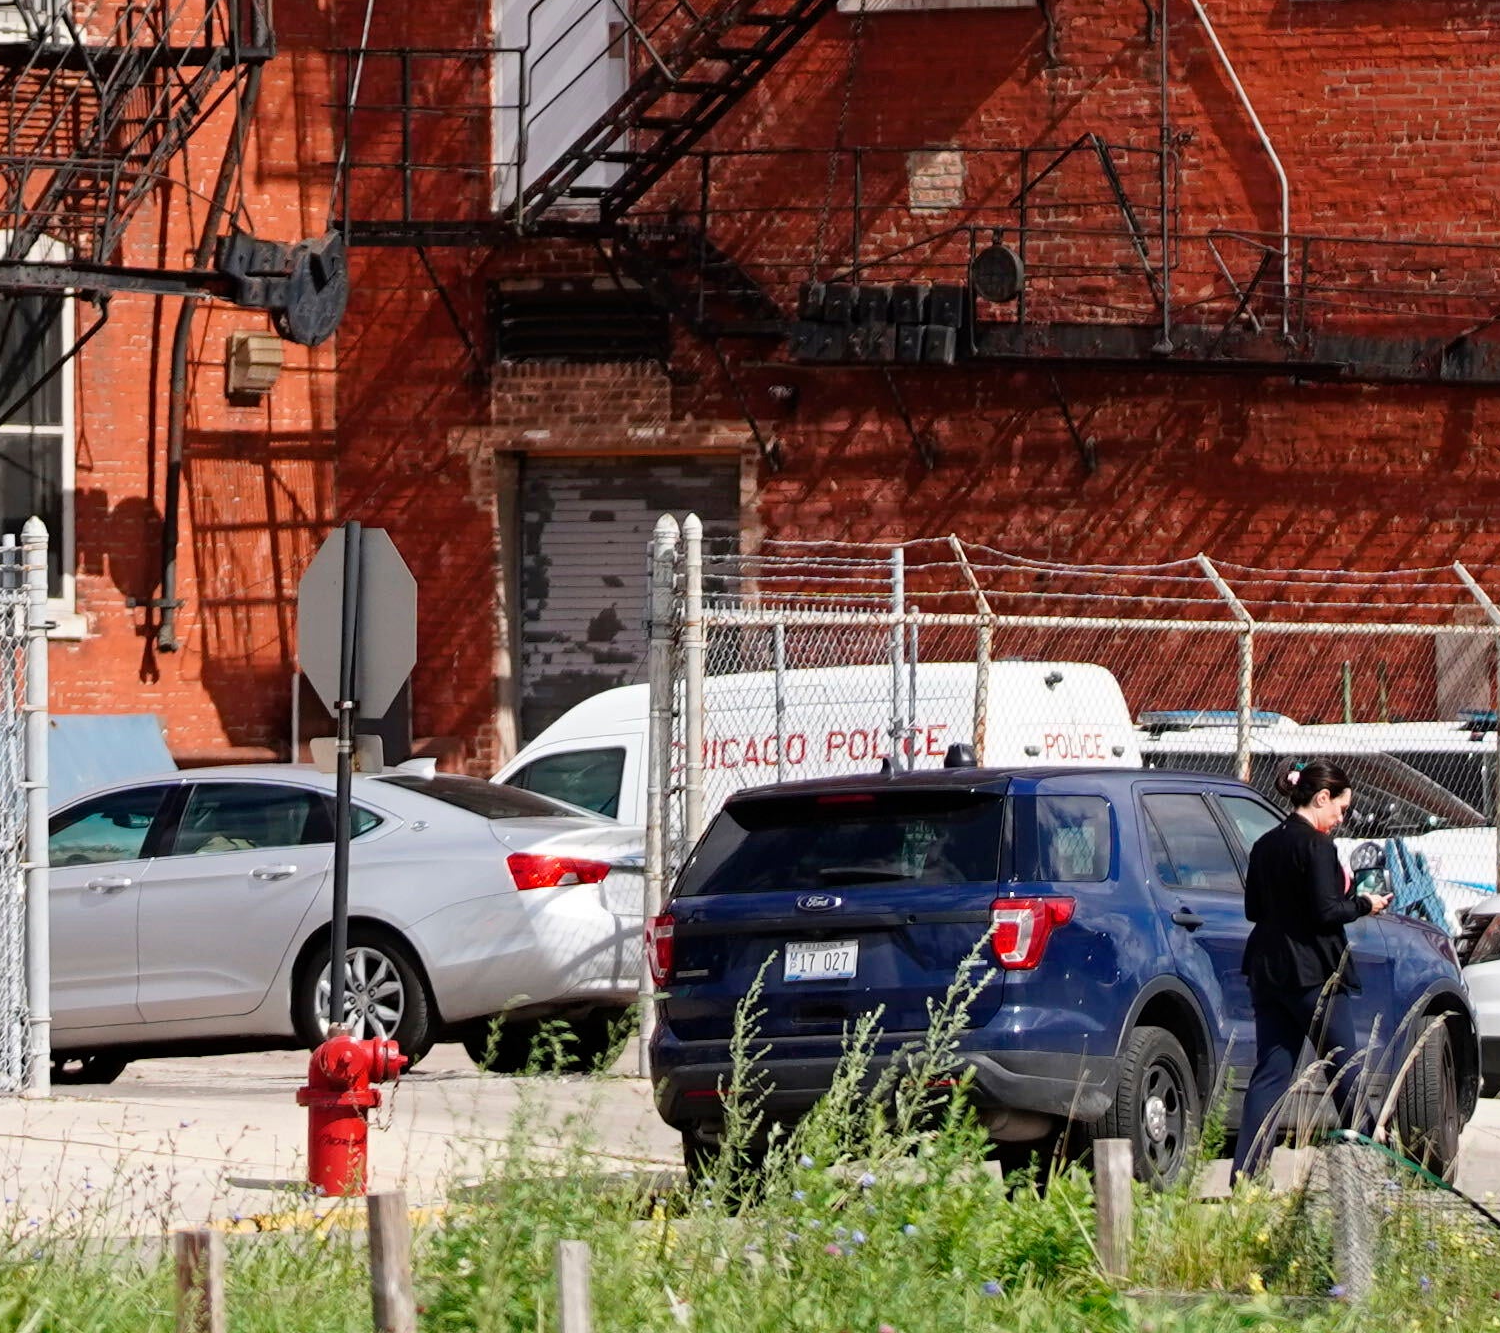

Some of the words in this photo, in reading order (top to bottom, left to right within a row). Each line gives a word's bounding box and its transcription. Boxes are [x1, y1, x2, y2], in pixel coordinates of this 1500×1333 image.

[825, 724, 947, 763] POLCE
[1043, 732, 1107, 761] POLICE
[800, 952, 816, 973] 17
[824, 951, 849, 971] 027
